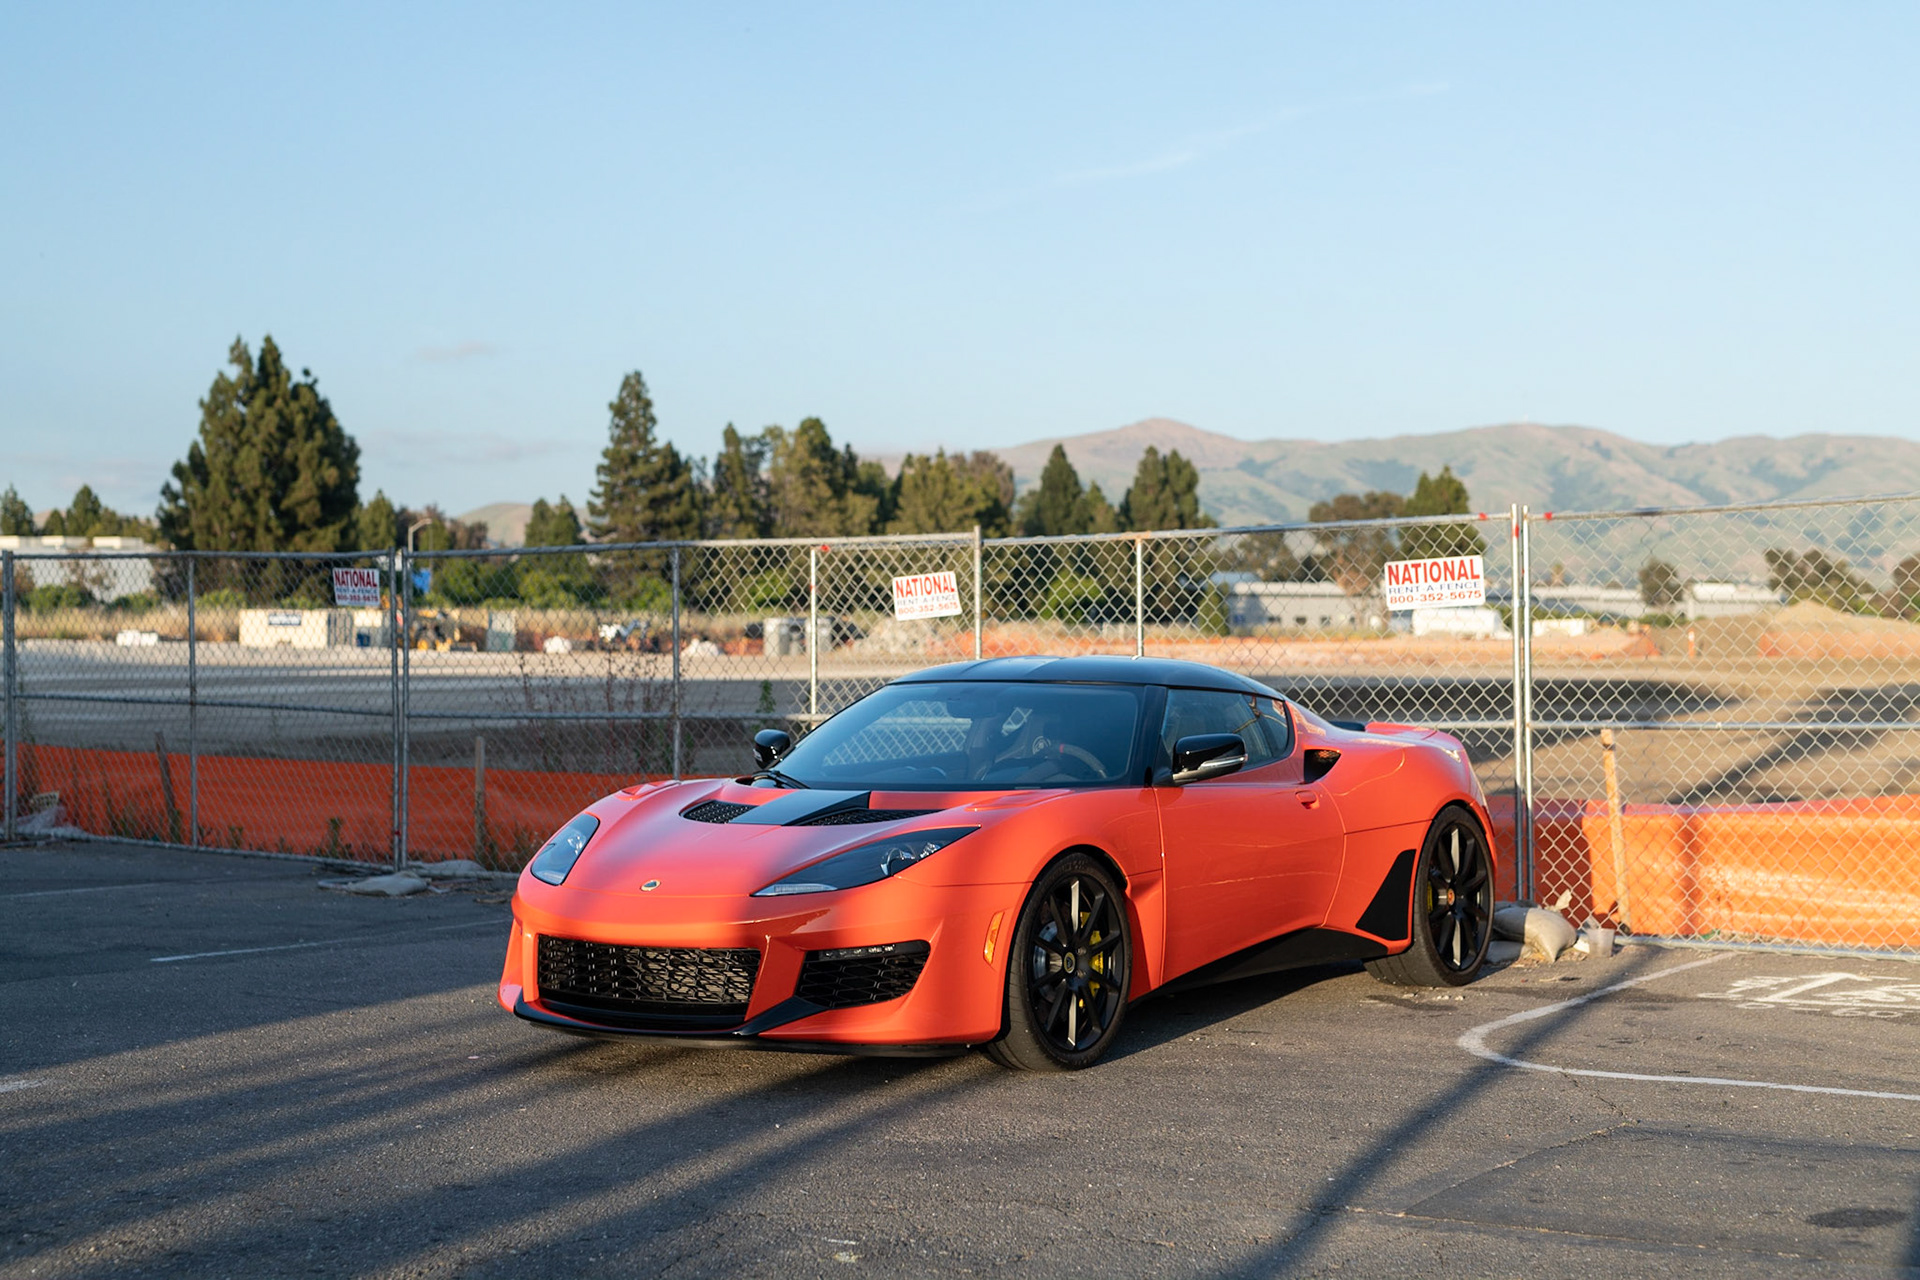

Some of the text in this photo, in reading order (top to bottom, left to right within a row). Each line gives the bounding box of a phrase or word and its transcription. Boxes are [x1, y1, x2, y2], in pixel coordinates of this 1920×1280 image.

[334, 570, 378, 588] NATIONAL
[1387, 559, 1480, 586] NATIONAL
[895, 574, 956, 599] NATIONAL
[1388, 581, 1480, 595] RENT-A-FENCE
[897, 593, 956, 606] RENT-A-FENCE
[1390, 590, 1482, 605] 800-352-5675
[898, 601, 959, 615] 800-352-5675
